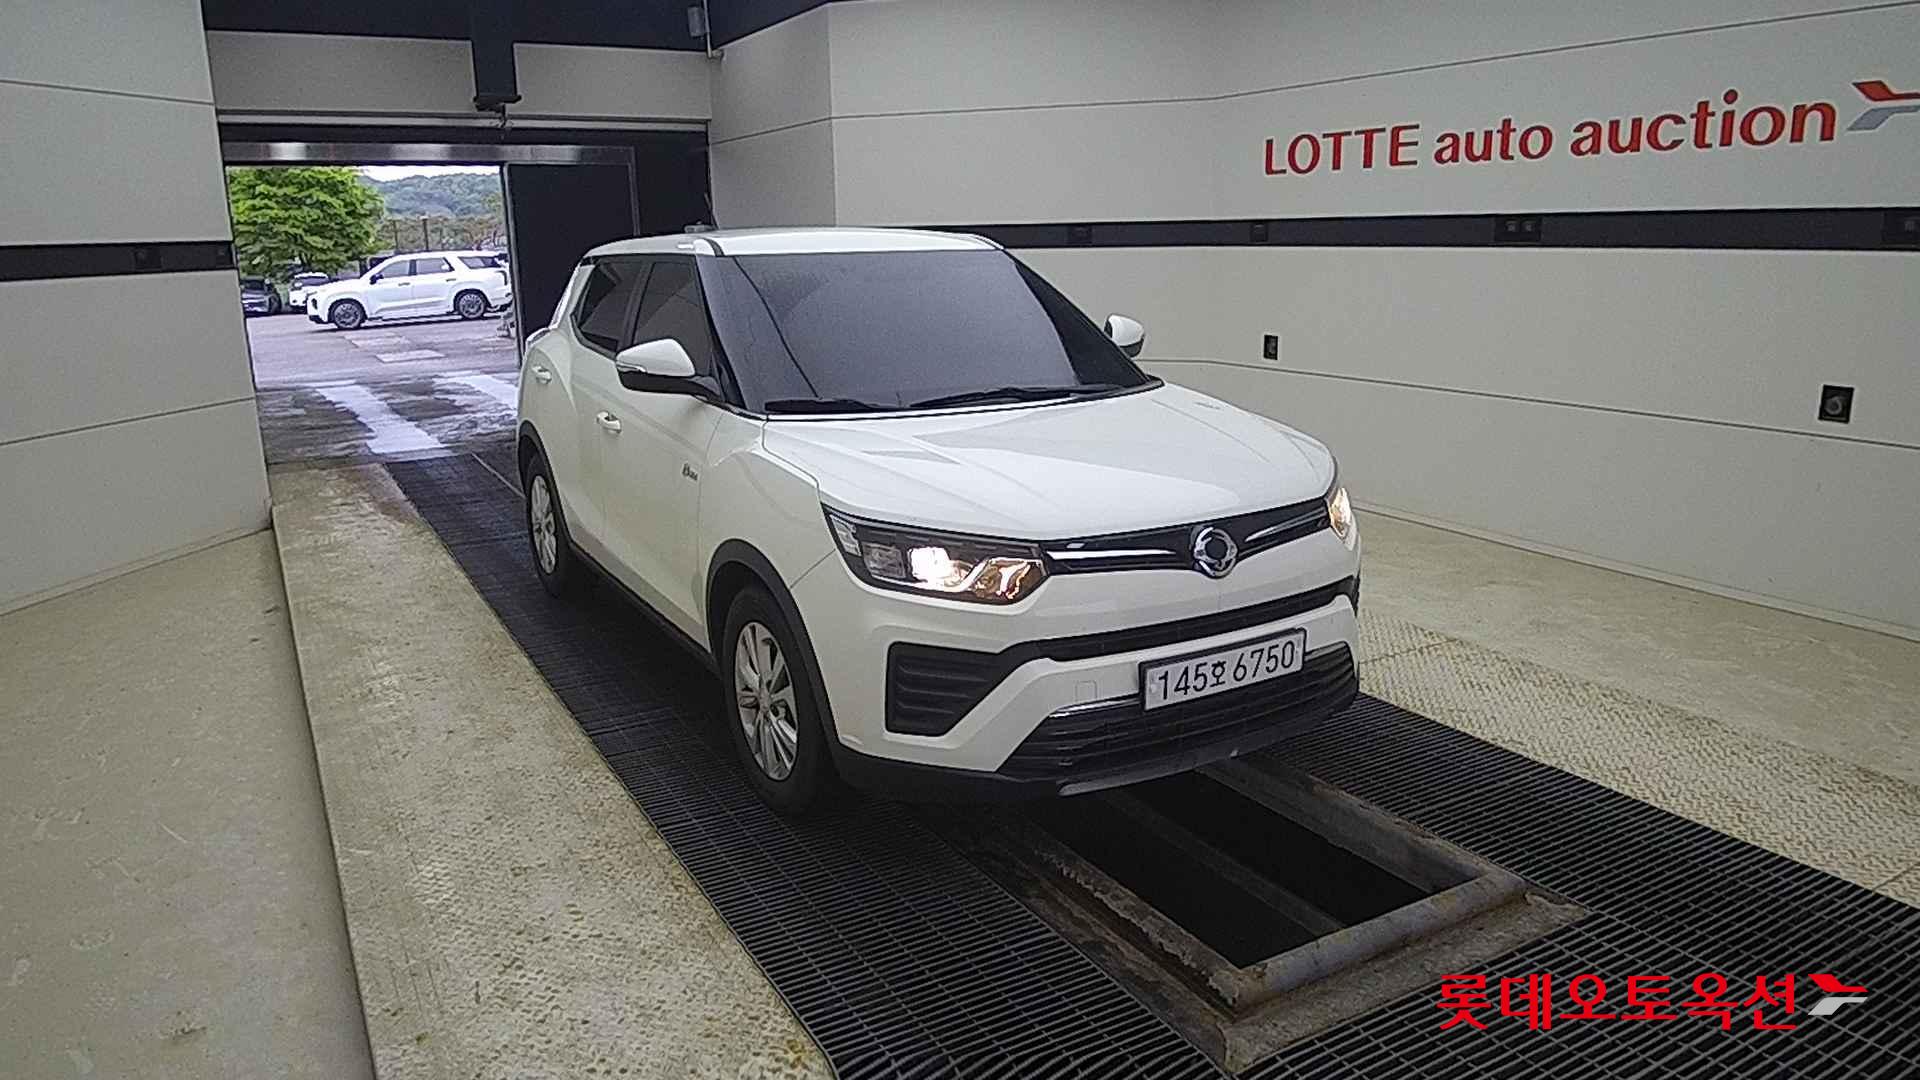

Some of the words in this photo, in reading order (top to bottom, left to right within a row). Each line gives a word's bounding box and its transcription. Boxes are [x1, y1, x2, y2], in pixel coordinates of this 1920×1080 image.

[1265, 123, 1420, 175] LOTTE
[1434, 118, 1553, 163] auto
[1571, 89, 1836, 157] auction
[1158, 660, 1227, 700] 145호
[1233, 640, 1295, 682] 6750
